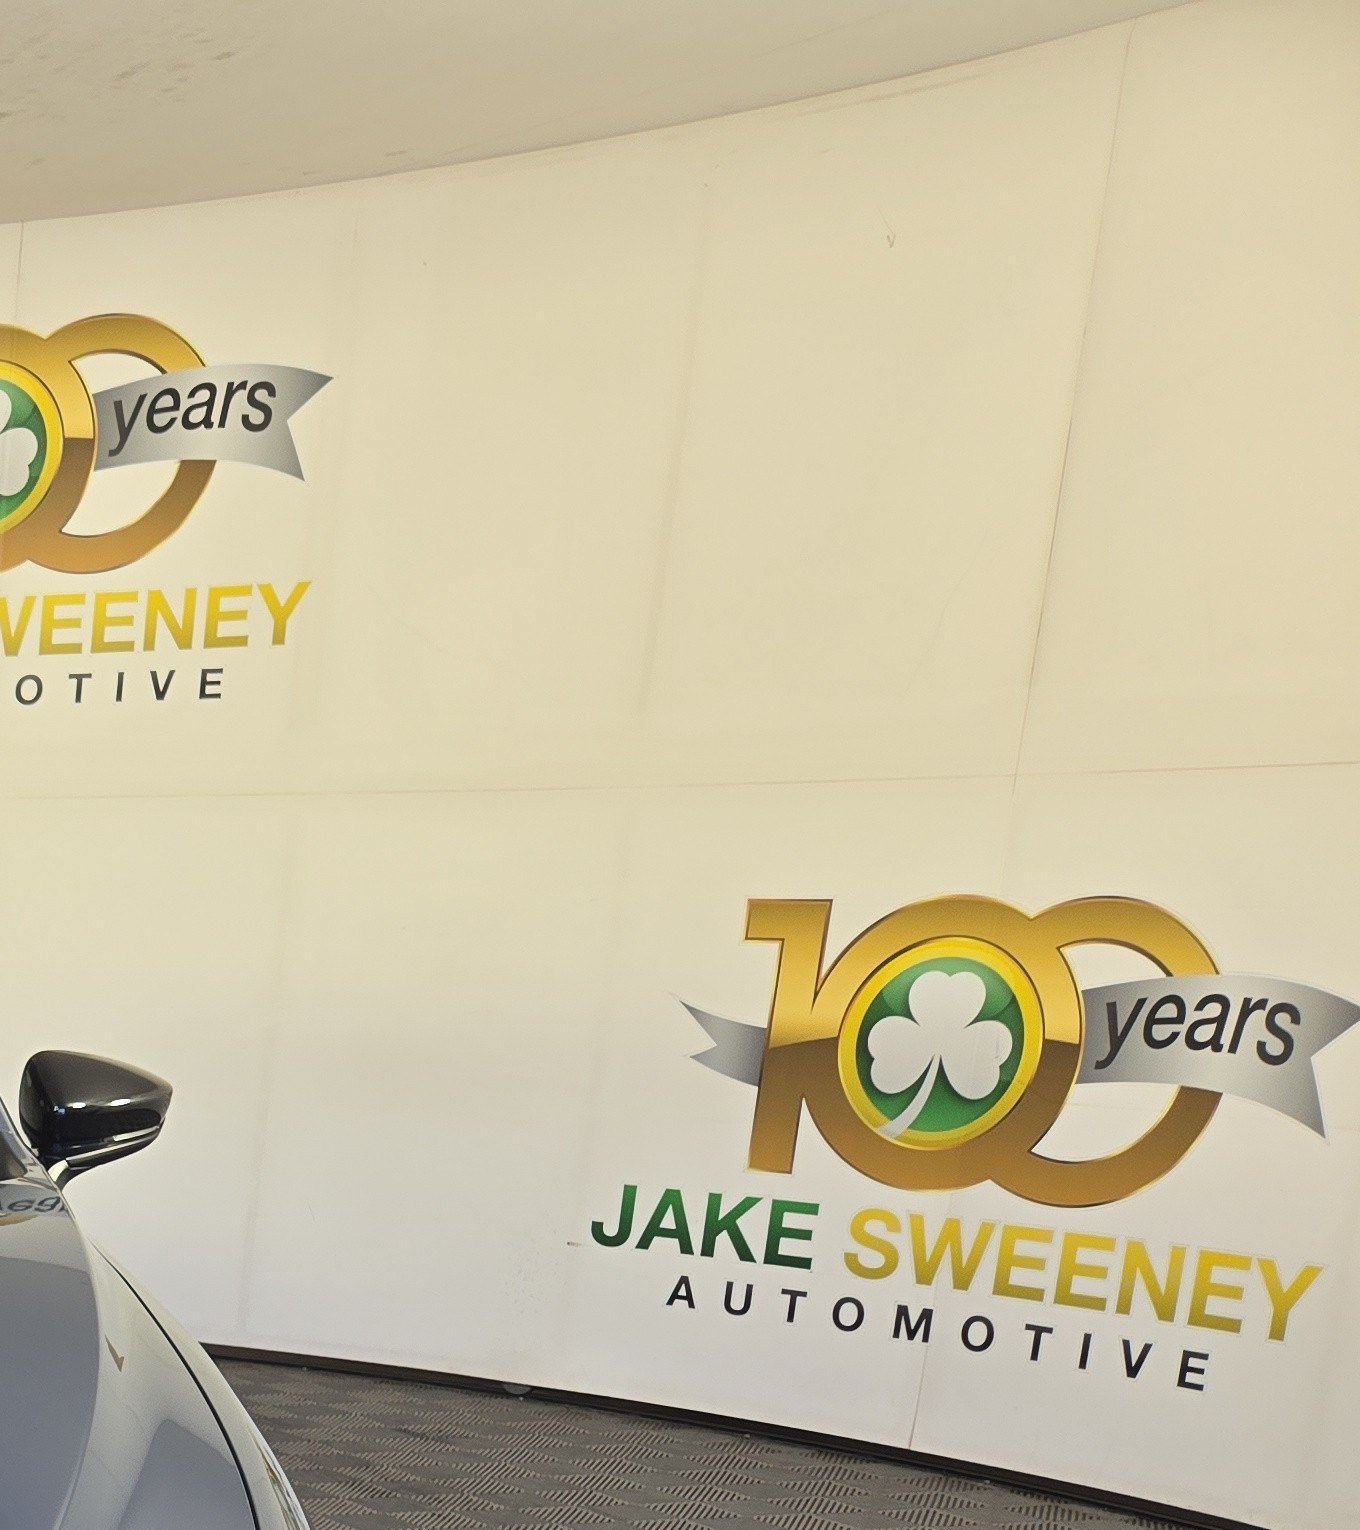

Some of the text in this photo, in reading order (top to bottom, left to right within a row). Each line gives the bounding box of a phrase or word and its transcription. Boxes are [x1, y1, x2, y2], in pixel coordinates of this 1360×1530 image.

[106, 378, 277, 457] years
[745, 894, 1225, 1208] 100
[1094, 990, 1303, 1070] years
[590, 1184, 1323, 1342] JAKE SWEENEY
[666, 1275, 1211, 1392] AUTOMOTIVE
